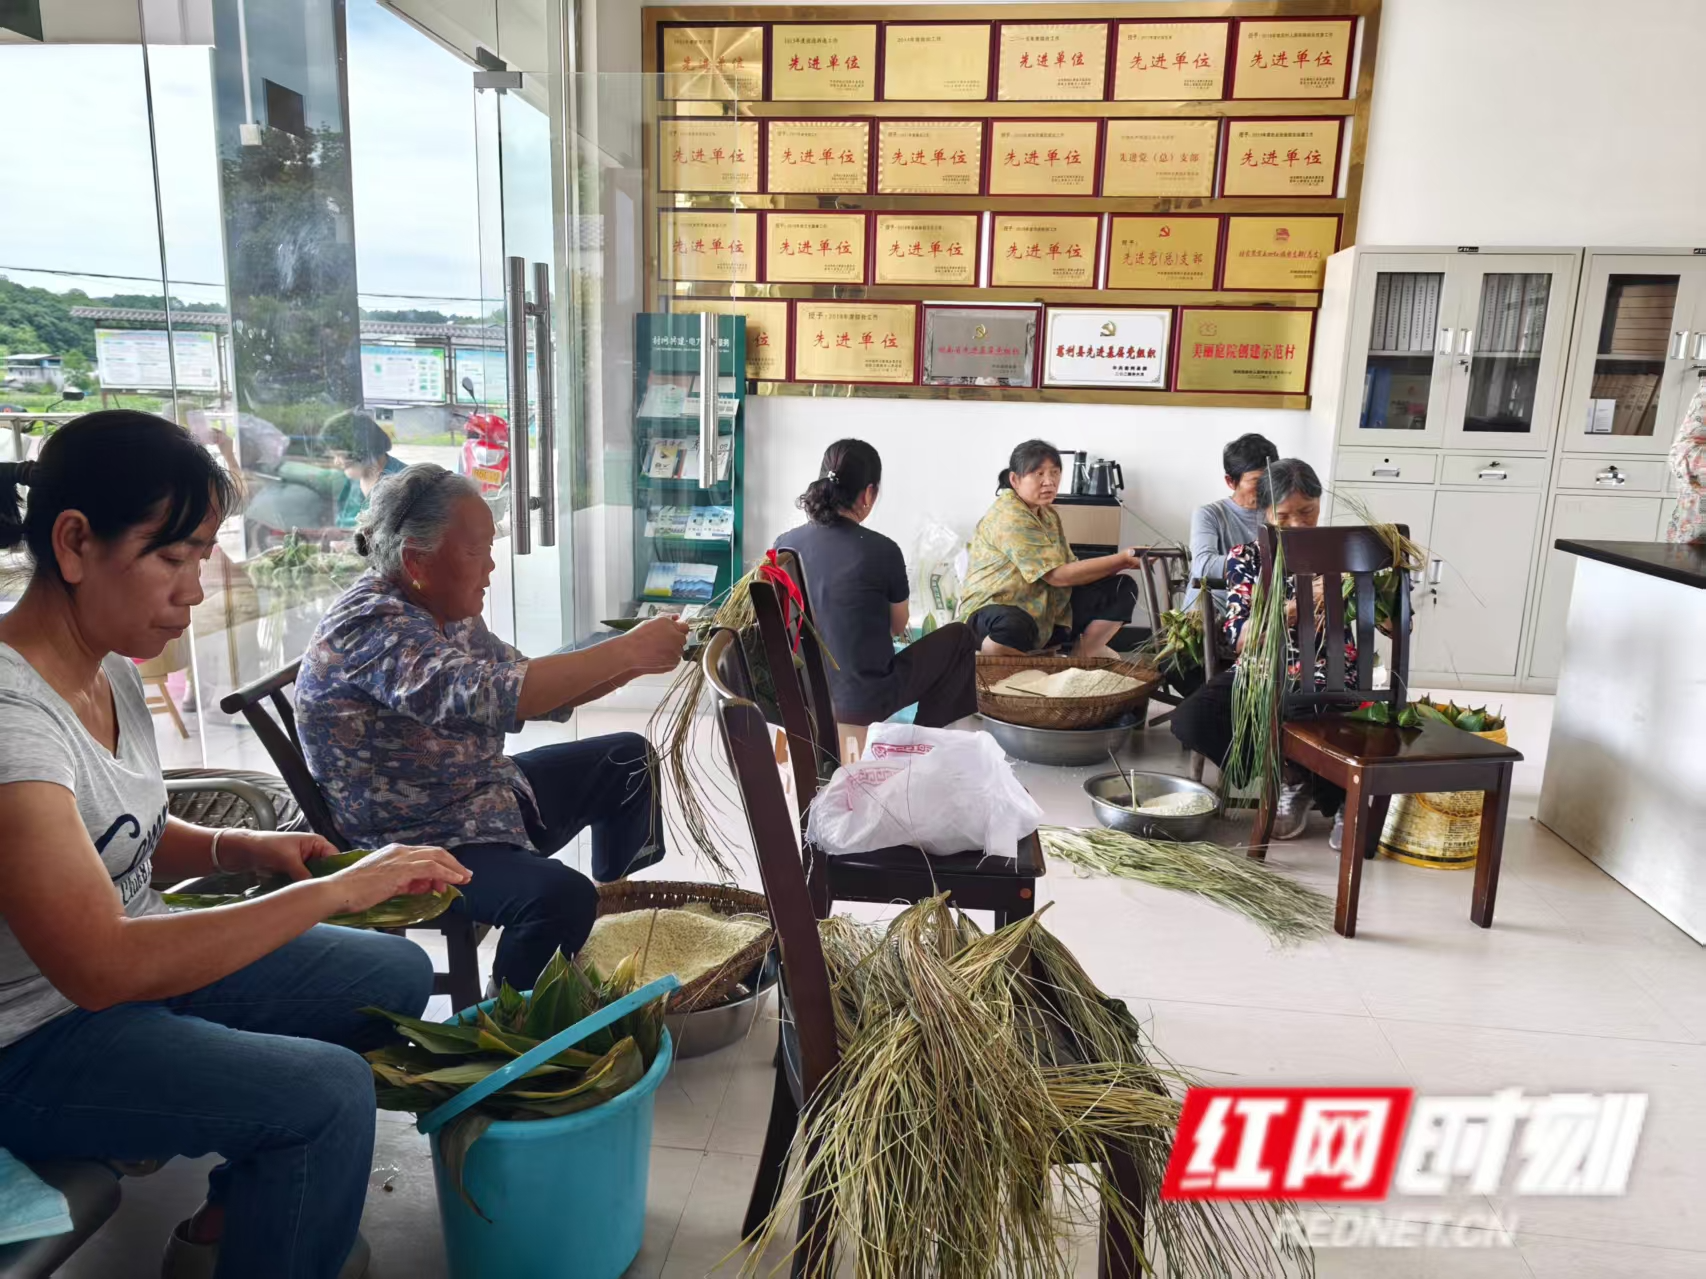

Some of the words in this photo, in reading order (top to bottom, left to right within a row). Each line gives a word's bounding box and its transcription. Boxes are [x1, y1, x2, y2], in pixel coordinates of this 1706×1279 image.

[682, 56, 745, 72] 先进单位
[788, 54, 861, 72] 先进单位
[1019, 51, 1086, 69] 先进单位
[1129, 52, 1213, 71] 先进单位
[1250, 49, 1335, 69] 先进单位
[672, 148, 747, 165] 先进单位
[781, 147, 857, 166] 先进单位
[891, 148, 968, 168] 先进单位
[1003, 148, 1083, 167] 先进单位
[1240, 148, 1323, 168] 先进单位
[672, 238, 746, 255] 先进单位
[779, 237, 853, 257] 先进单位
[889, 240, 965, 259] 先进单位
[1006, 241, 1084, 261] 先进单位
[813, 332, 900, 350] 先进单位
[1055, 343, 1158, 361] 慈利县先进基层党组织
[1191, 342, 1297, 361] 美丽庭院创建示范村
